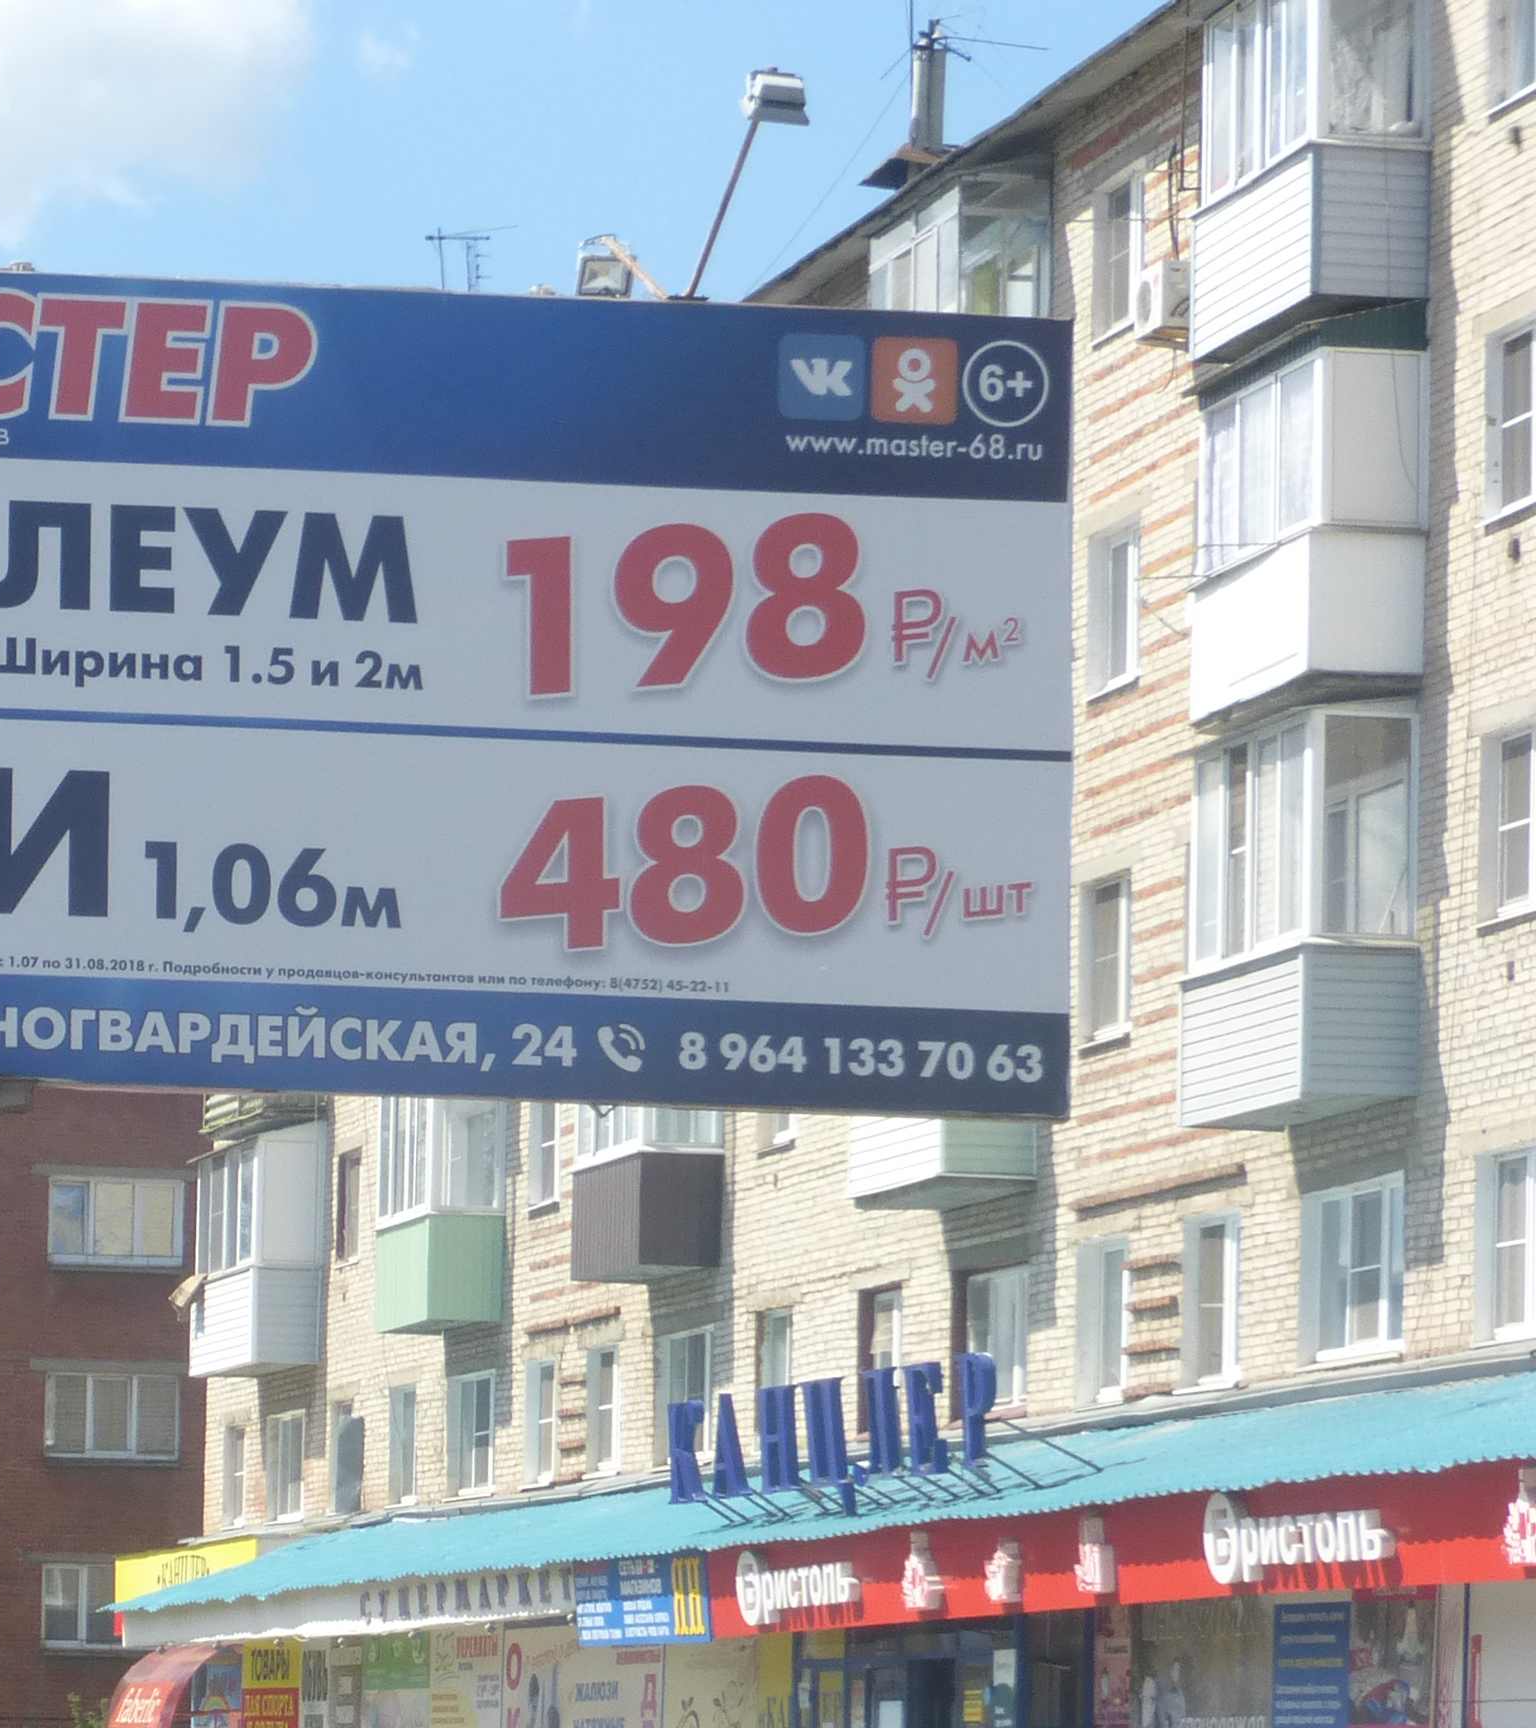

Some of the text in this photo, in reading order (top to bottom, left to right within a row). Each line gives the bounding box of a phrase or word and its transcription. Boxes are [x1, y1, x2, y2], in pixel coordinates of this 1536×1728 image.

[979, 362, 1032, 402] 6+
[786, 432, 1043, 462] www.master-68.ru
[506, 512, 868, 698] 198
[224, 646, 296, 686] 1.5
[310, 660, 340, 686] и
[357, 651, 423, 692] 2м
[145, 841, 402, 932] 1,06м
[498, 774, 870, 952] 480
[9, 955, 38, 968] 1.07
[42, 960, 61, 969] по
[65, 958, 145, 972] 31.08.2018
[148, 962, 158, 972] г.
[163, 961, 262, 977] Подробности
[266, 967, 275, 979] у
[278, 966, 474, 985] продавцов-консультантов
[478, 975, 505, 985] или
[509, 975, 527, 985] по
[531, 975, 607, 990] телефону:
[512, 1025, 576, 1068] 24
[678, 1032, 706, 1072] 8
[718, 1035, 806, 1073] 964
[825, 1037, 900, 1077] 133
[918, 1041, 974, 1080] 70
[986, 1043, 1044, 1083] 63
[667, 1352, 997, 1517] КАНЦЛЕР
[1203, 1492, 1394, 1584] Бристоль
[359, 1566, 573, 1625] СУПЕРМАРКЕТ
[735, 1551, 860, 1626] Бристоль
[251, 1648, 290, 1681] ТОВАРЫ
[575, 1681, 619, 1702] ЖАЛЮЗИ
